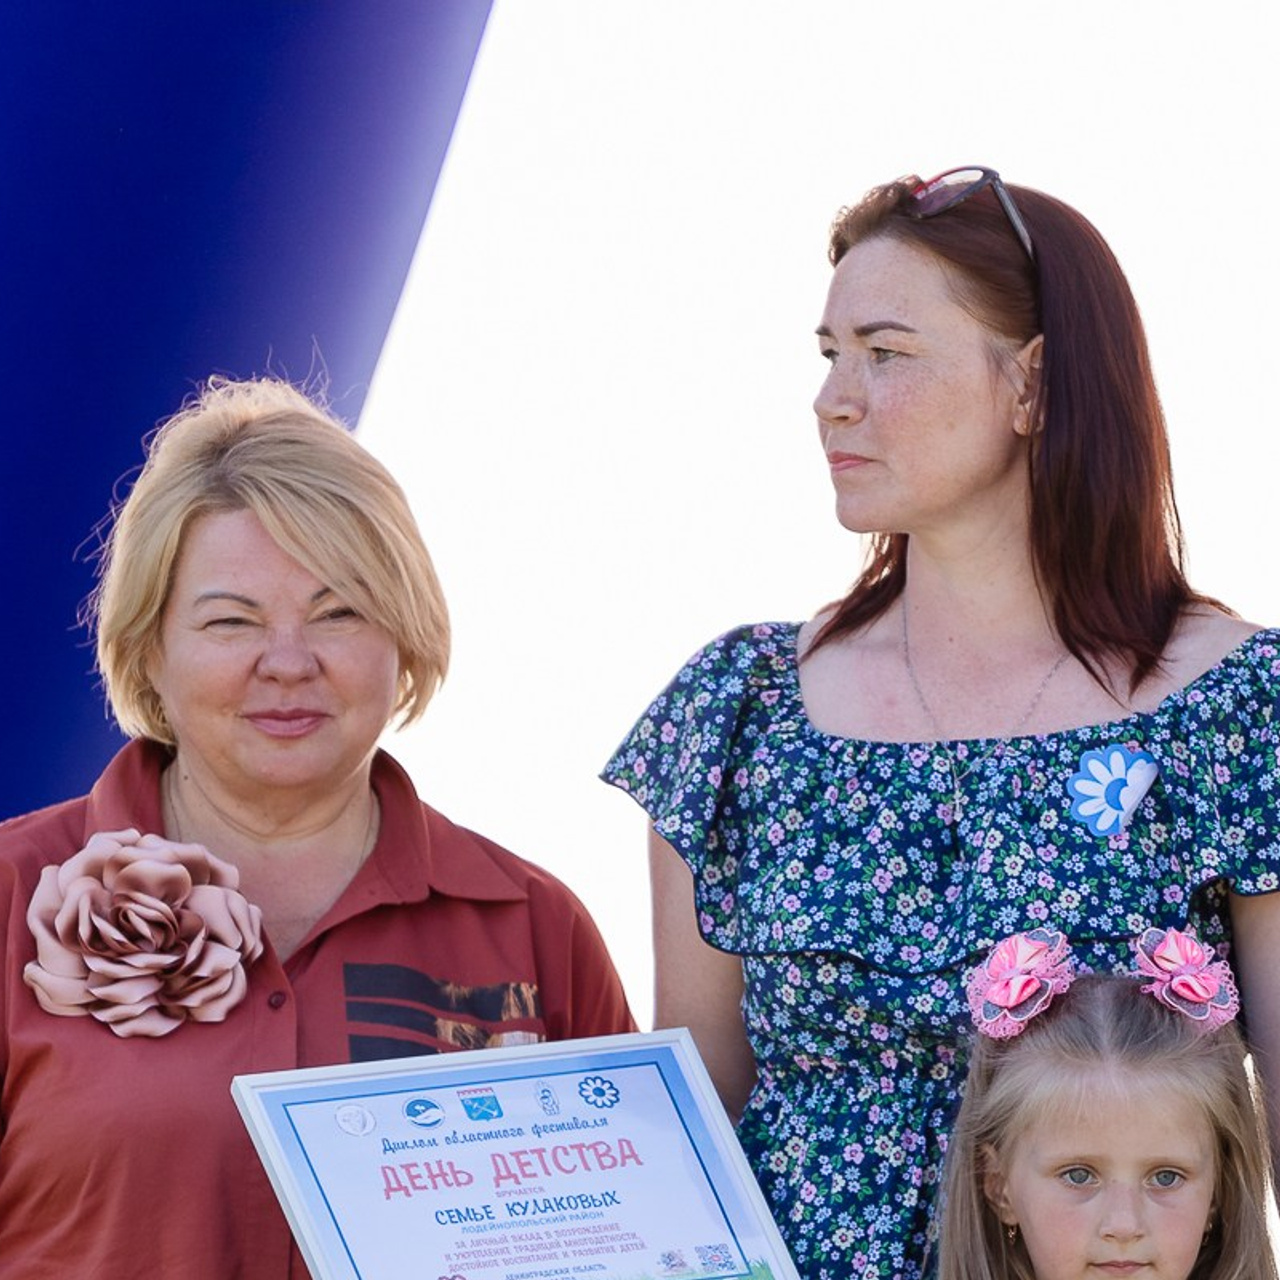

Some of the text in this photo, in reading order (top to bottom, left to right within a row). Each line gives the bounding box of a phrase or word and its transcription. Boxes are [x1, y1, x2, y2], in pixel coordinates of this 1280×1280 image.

[381, 1117, 609, 1154] Диплом областного фестиваля
[381, 1138, 644, 1200] ДЕНЬ ДЕТСТВА
[434, 1190, 622, 1226] СЕМЬЕ КУЛАКОВЫХ
[461, 1210, 605, 1234] ЛОДЕЙНОПОЛЬСКИЙ РАЙОН
